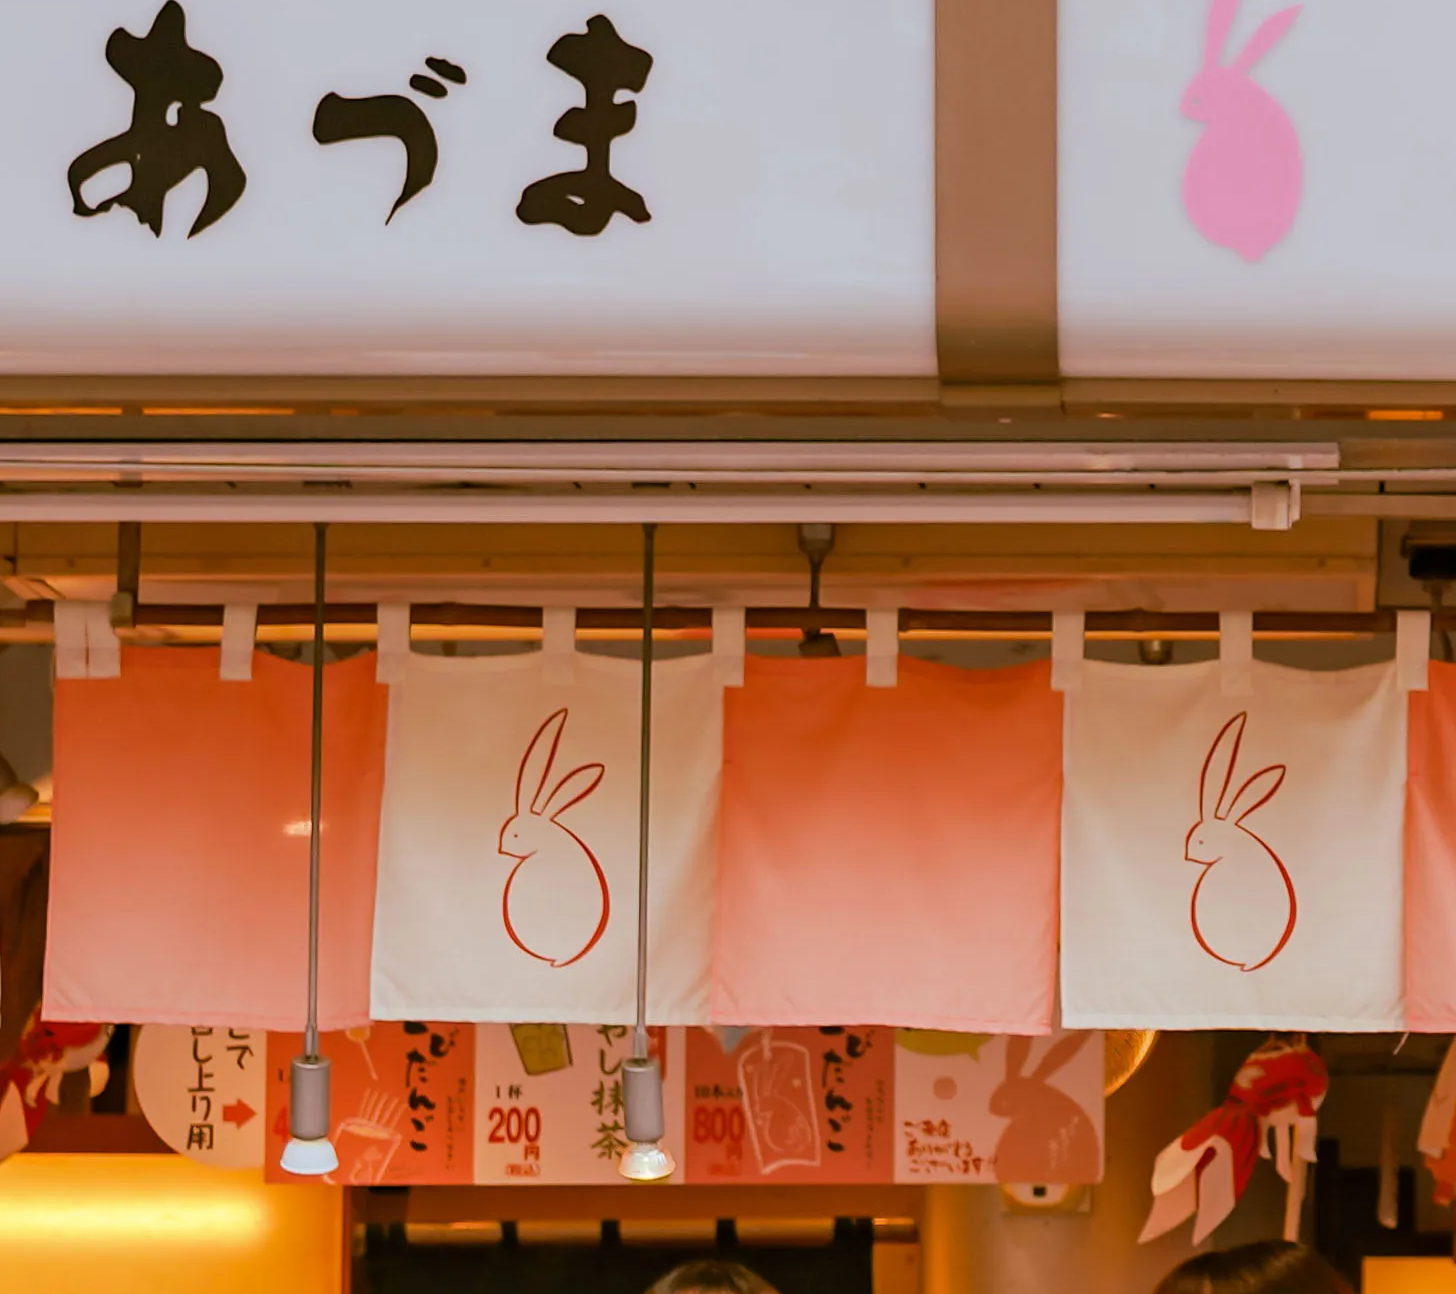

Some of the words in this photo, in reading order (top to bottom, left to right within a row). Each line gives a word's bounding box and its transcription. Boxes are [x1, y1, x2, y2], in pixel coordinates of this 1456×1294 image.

[487, 1107, 542, 1144] 200
[693, 1106, 745, 1144] 800
[524, 1145, 540, 1161] 円
